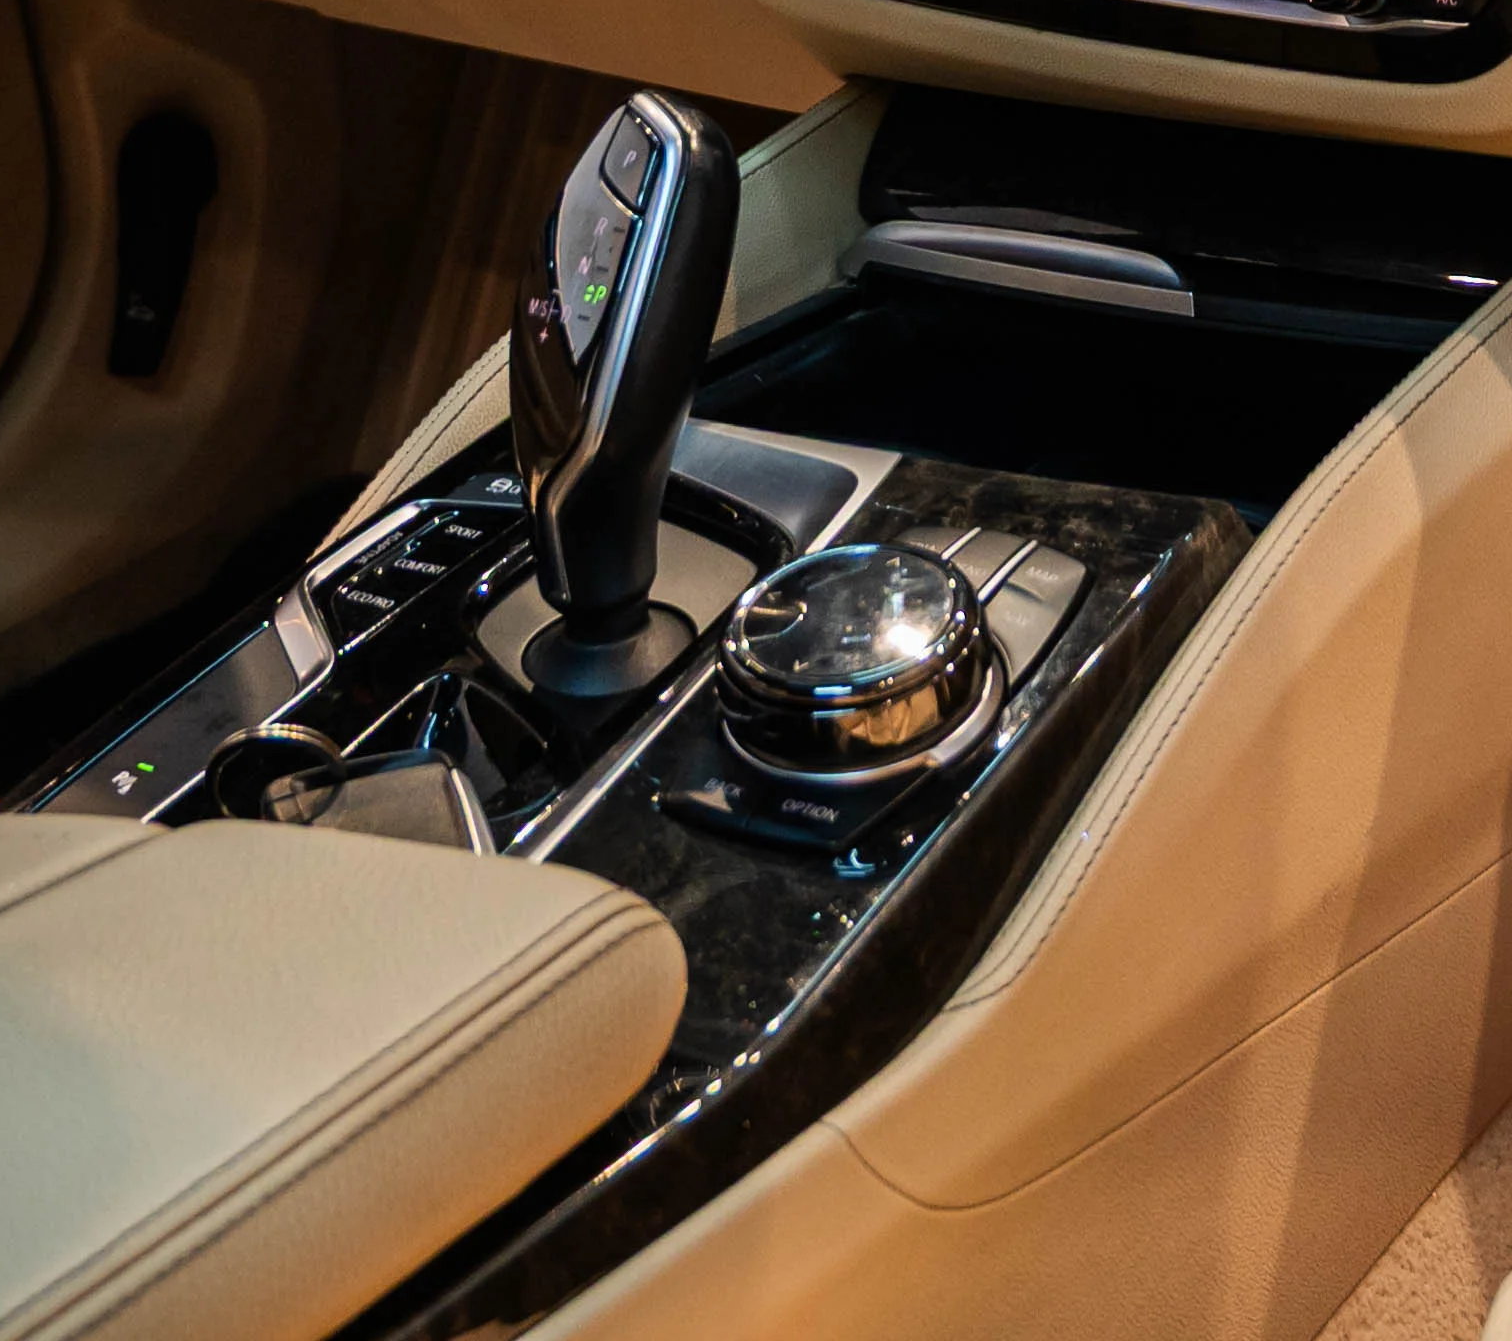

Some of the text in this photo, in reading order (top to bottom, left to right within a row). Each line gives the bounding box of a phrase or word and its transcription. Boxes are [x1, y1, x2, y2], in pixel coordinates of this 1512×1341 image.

[623, 149, 637, 168] P
[594, 216, 609, 236] R
[444, 523, 484, 541] SPORT
[393, 557, 448, 576] COMFORT
[1025, 566, 1059, 582] MAP
[346, 589, 395, 609] ECO PRO
[703, 776, 744, 798] BACK
[780, 798, 839, 824] OPTION
